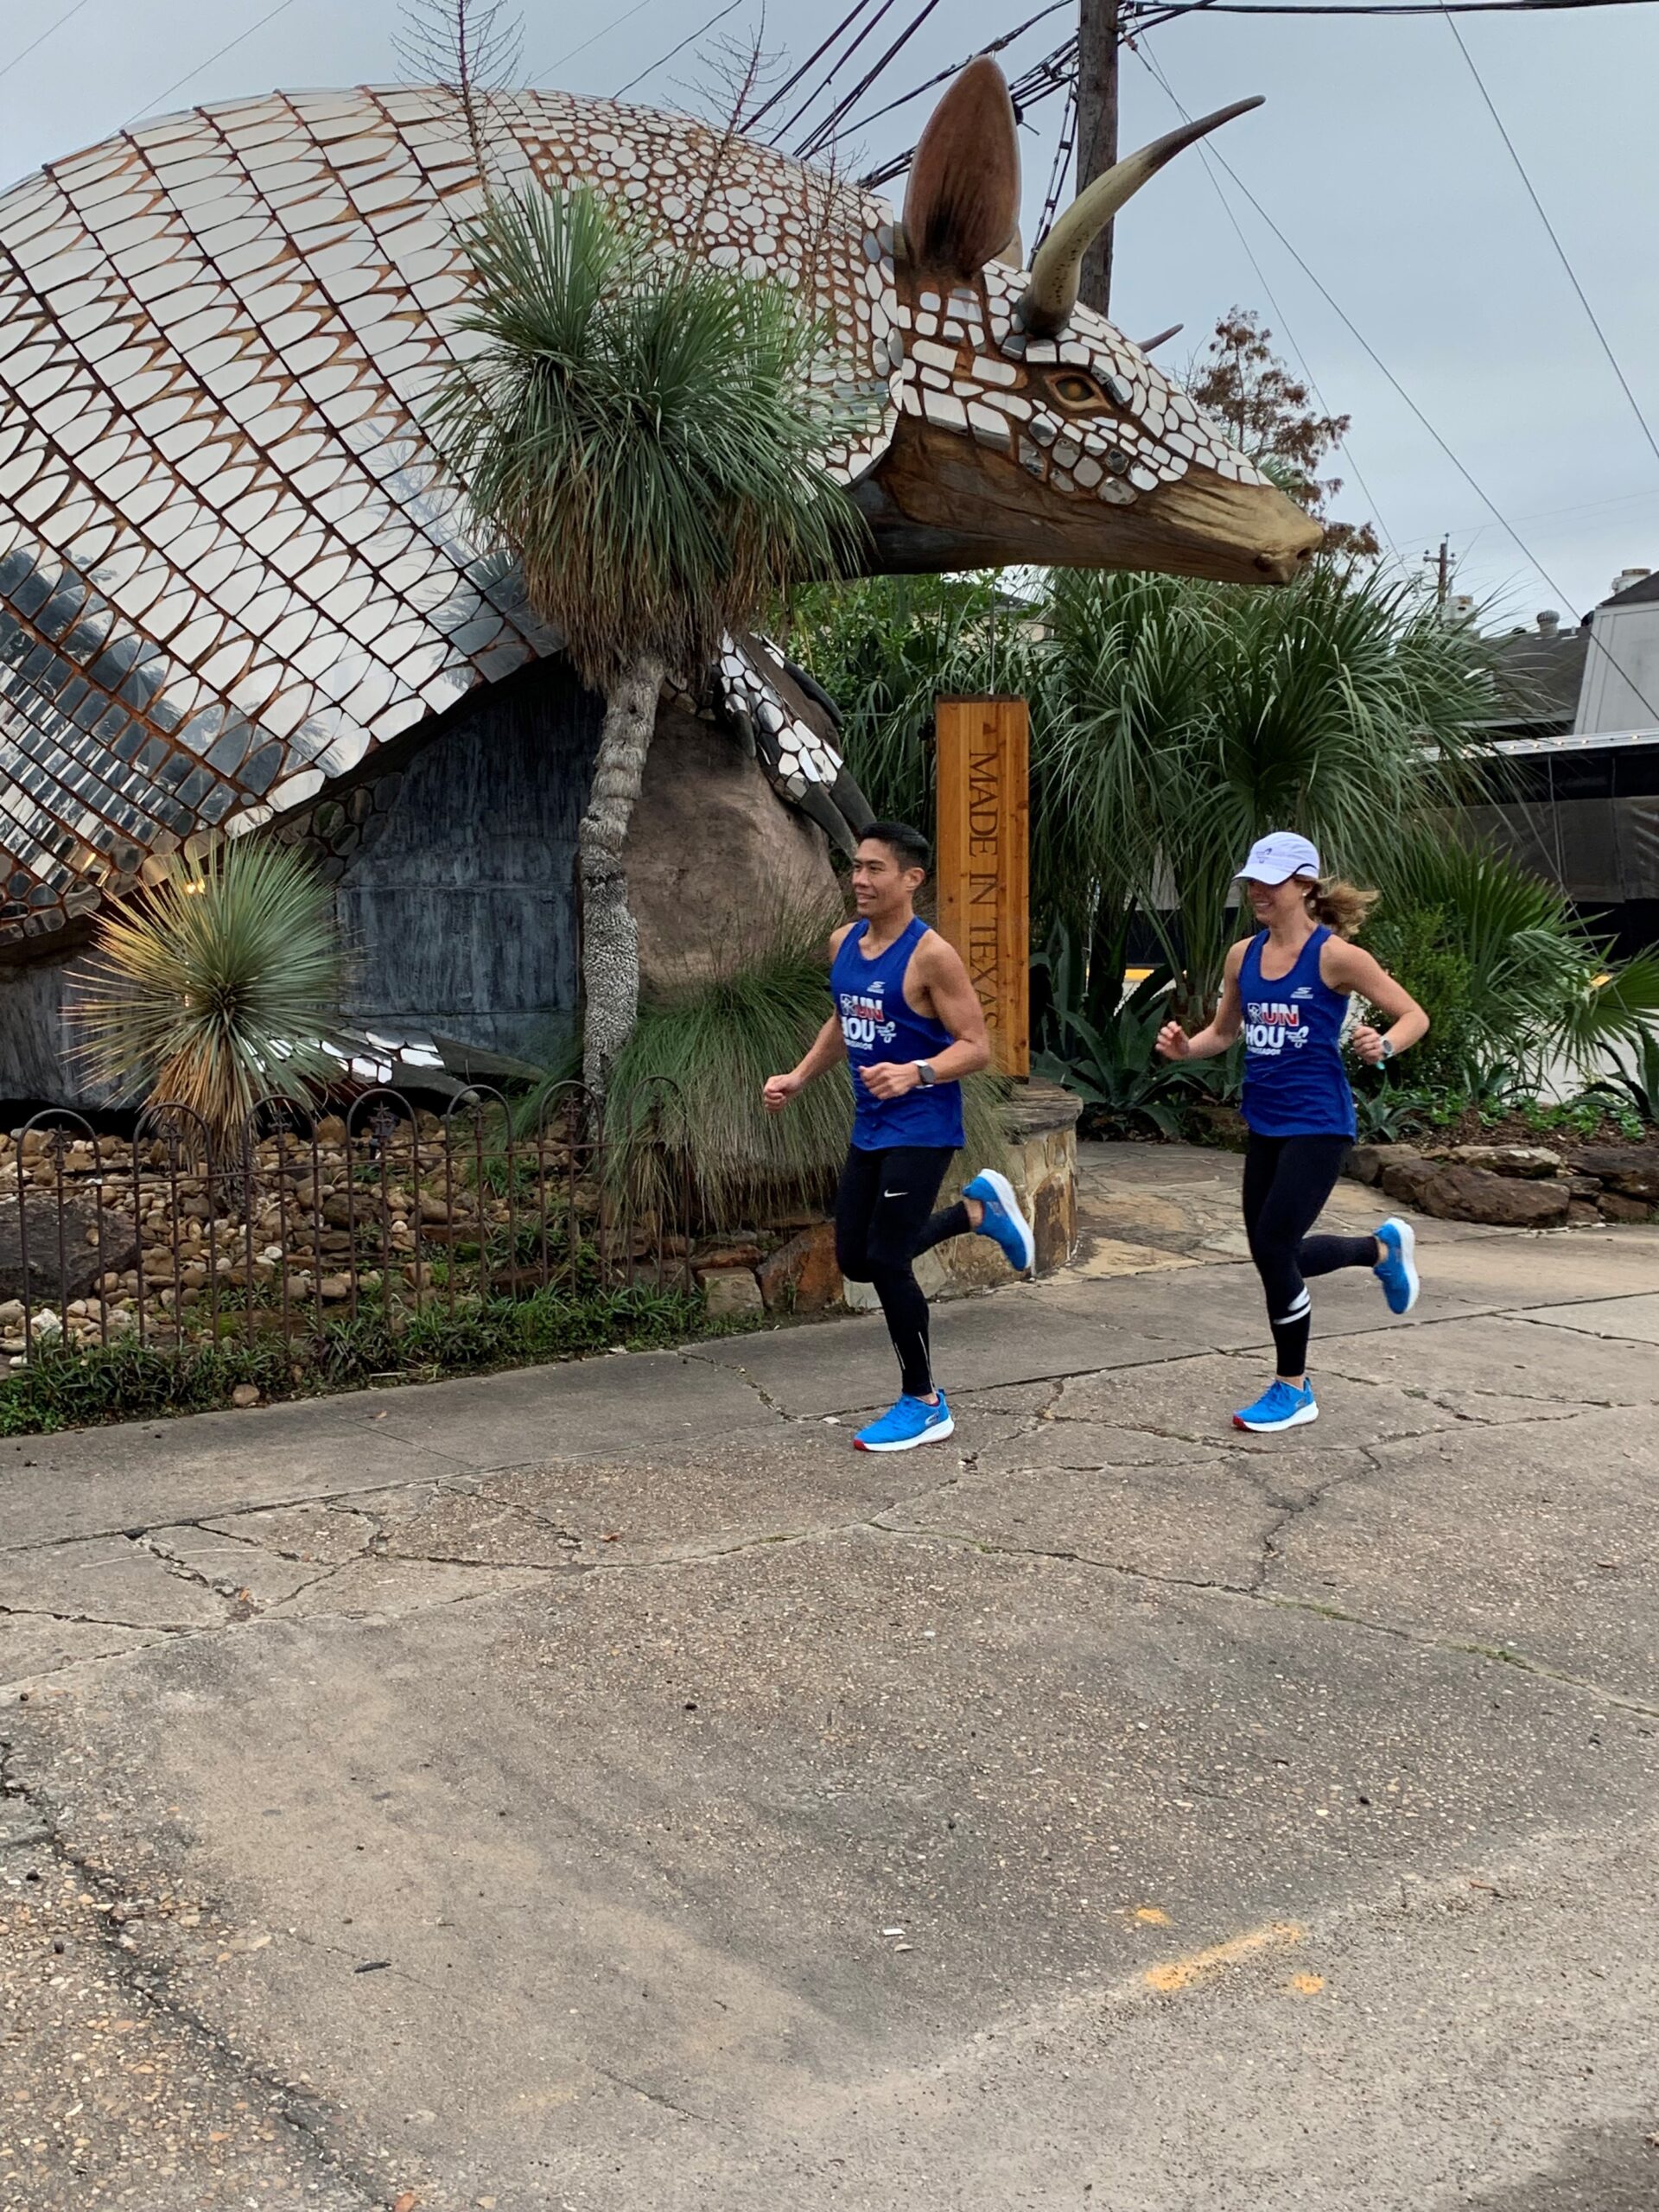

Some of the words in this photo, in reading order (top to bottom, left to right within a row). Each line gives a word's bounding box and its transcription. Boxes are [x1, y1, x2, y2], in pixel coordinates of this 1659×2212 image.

[968, 749, 999, 857] MADE
[968, 873, 999, 906] IN
[840, 993, 885, 1022] RUN
[1247, 1002, 1300, 1027] RUN
[1245, 1023, 1286, 1048] HOU
